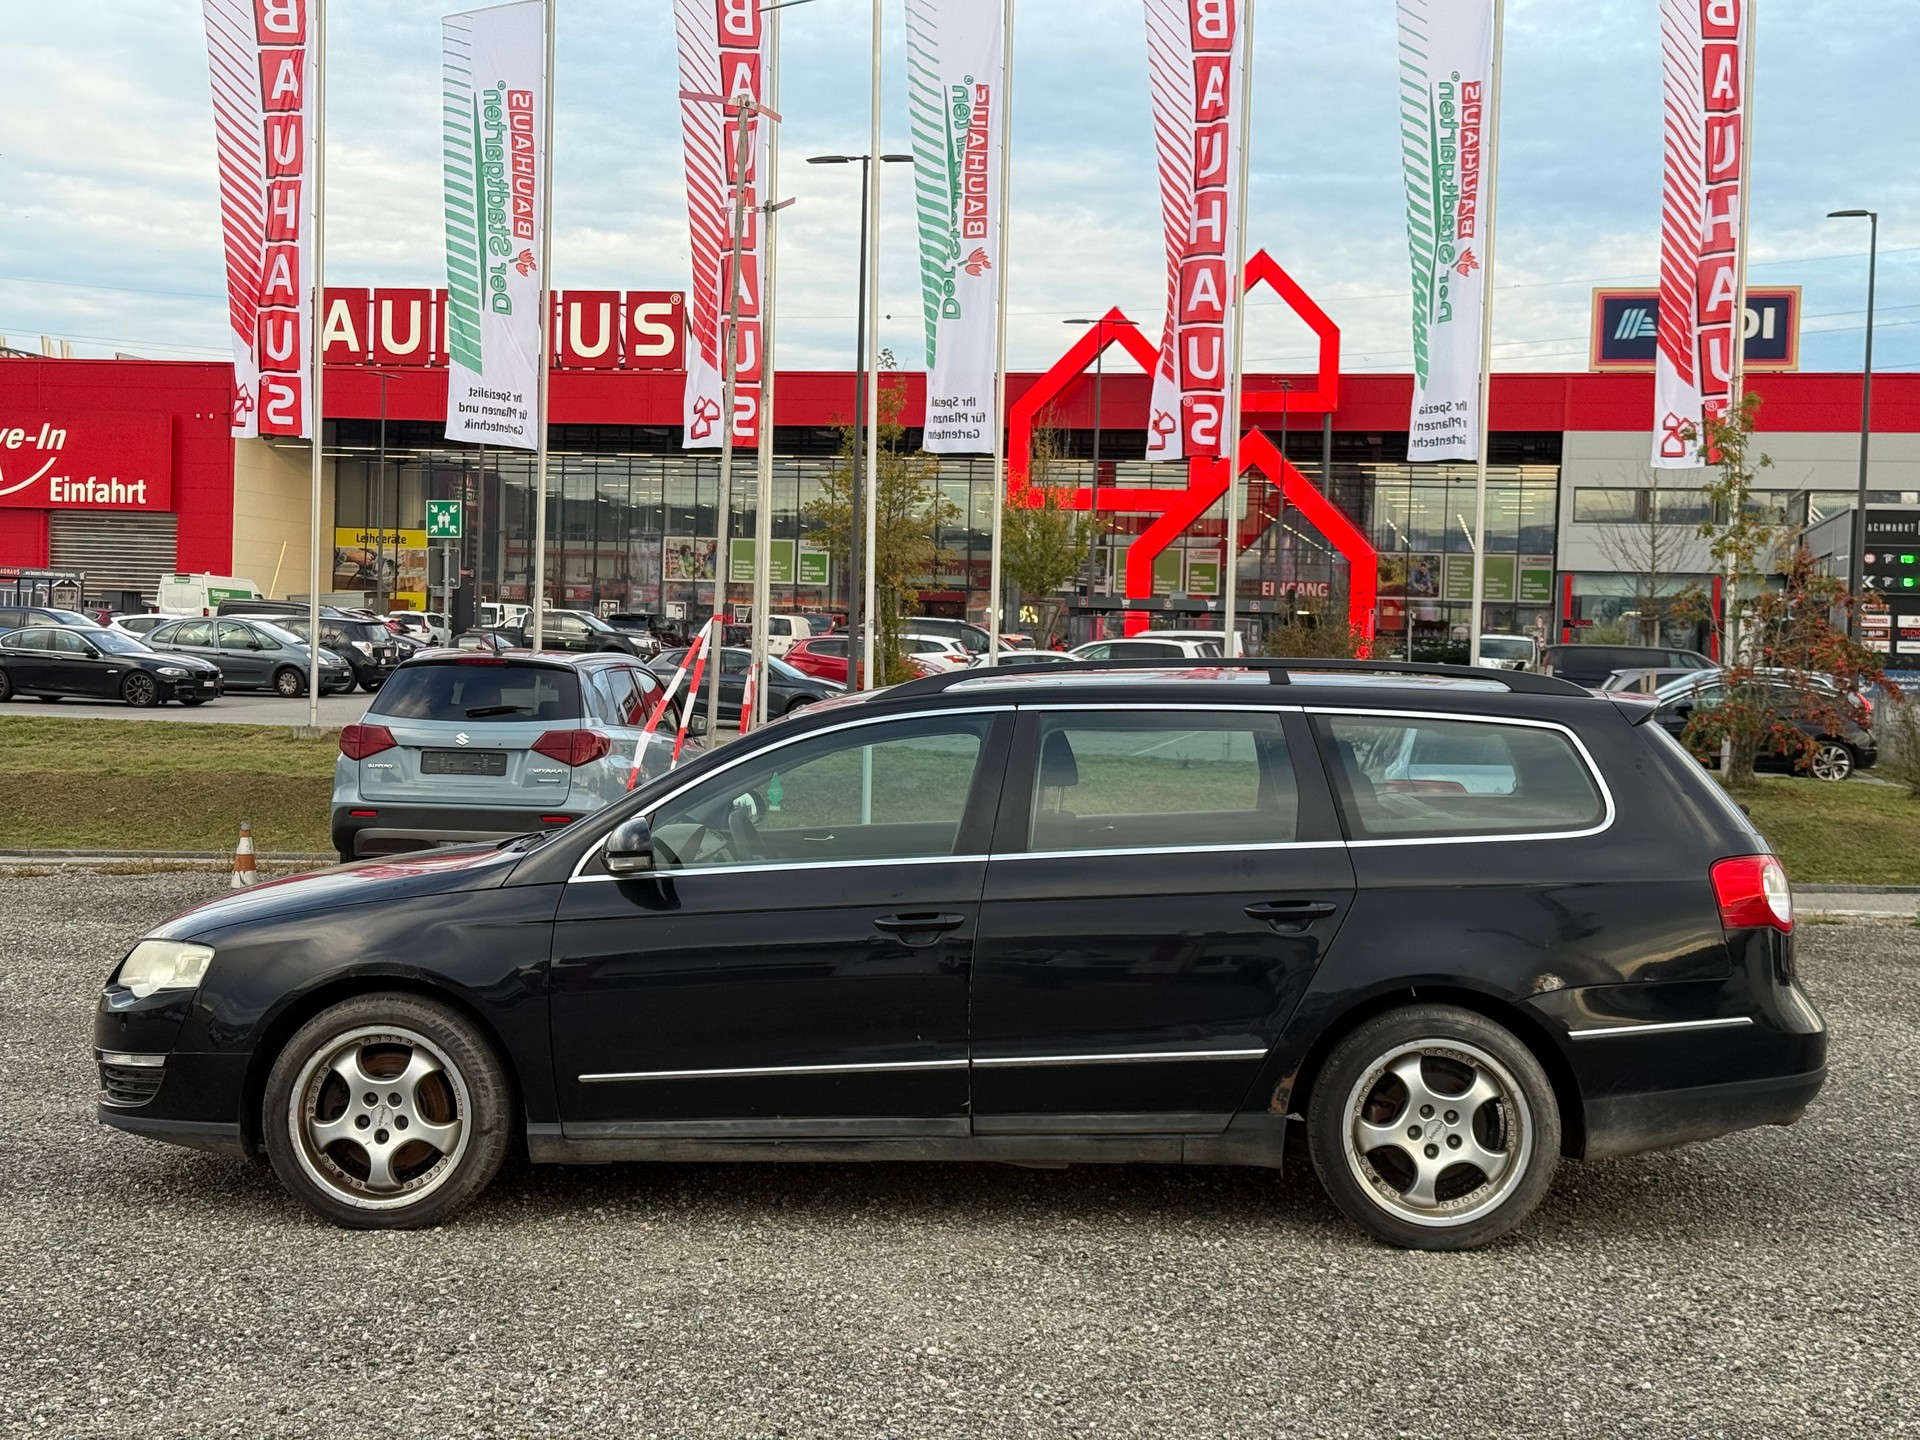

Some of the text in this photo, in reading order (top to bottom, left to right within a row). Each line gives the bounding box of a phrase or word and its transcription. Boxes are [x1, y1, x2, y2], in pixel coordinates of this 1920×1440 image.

[50, 475, 147, 504] Einfahrt
[1867, 522, 1915, 532] ACHMARKT
[356, 533, 407, 546] Leihgeräte
